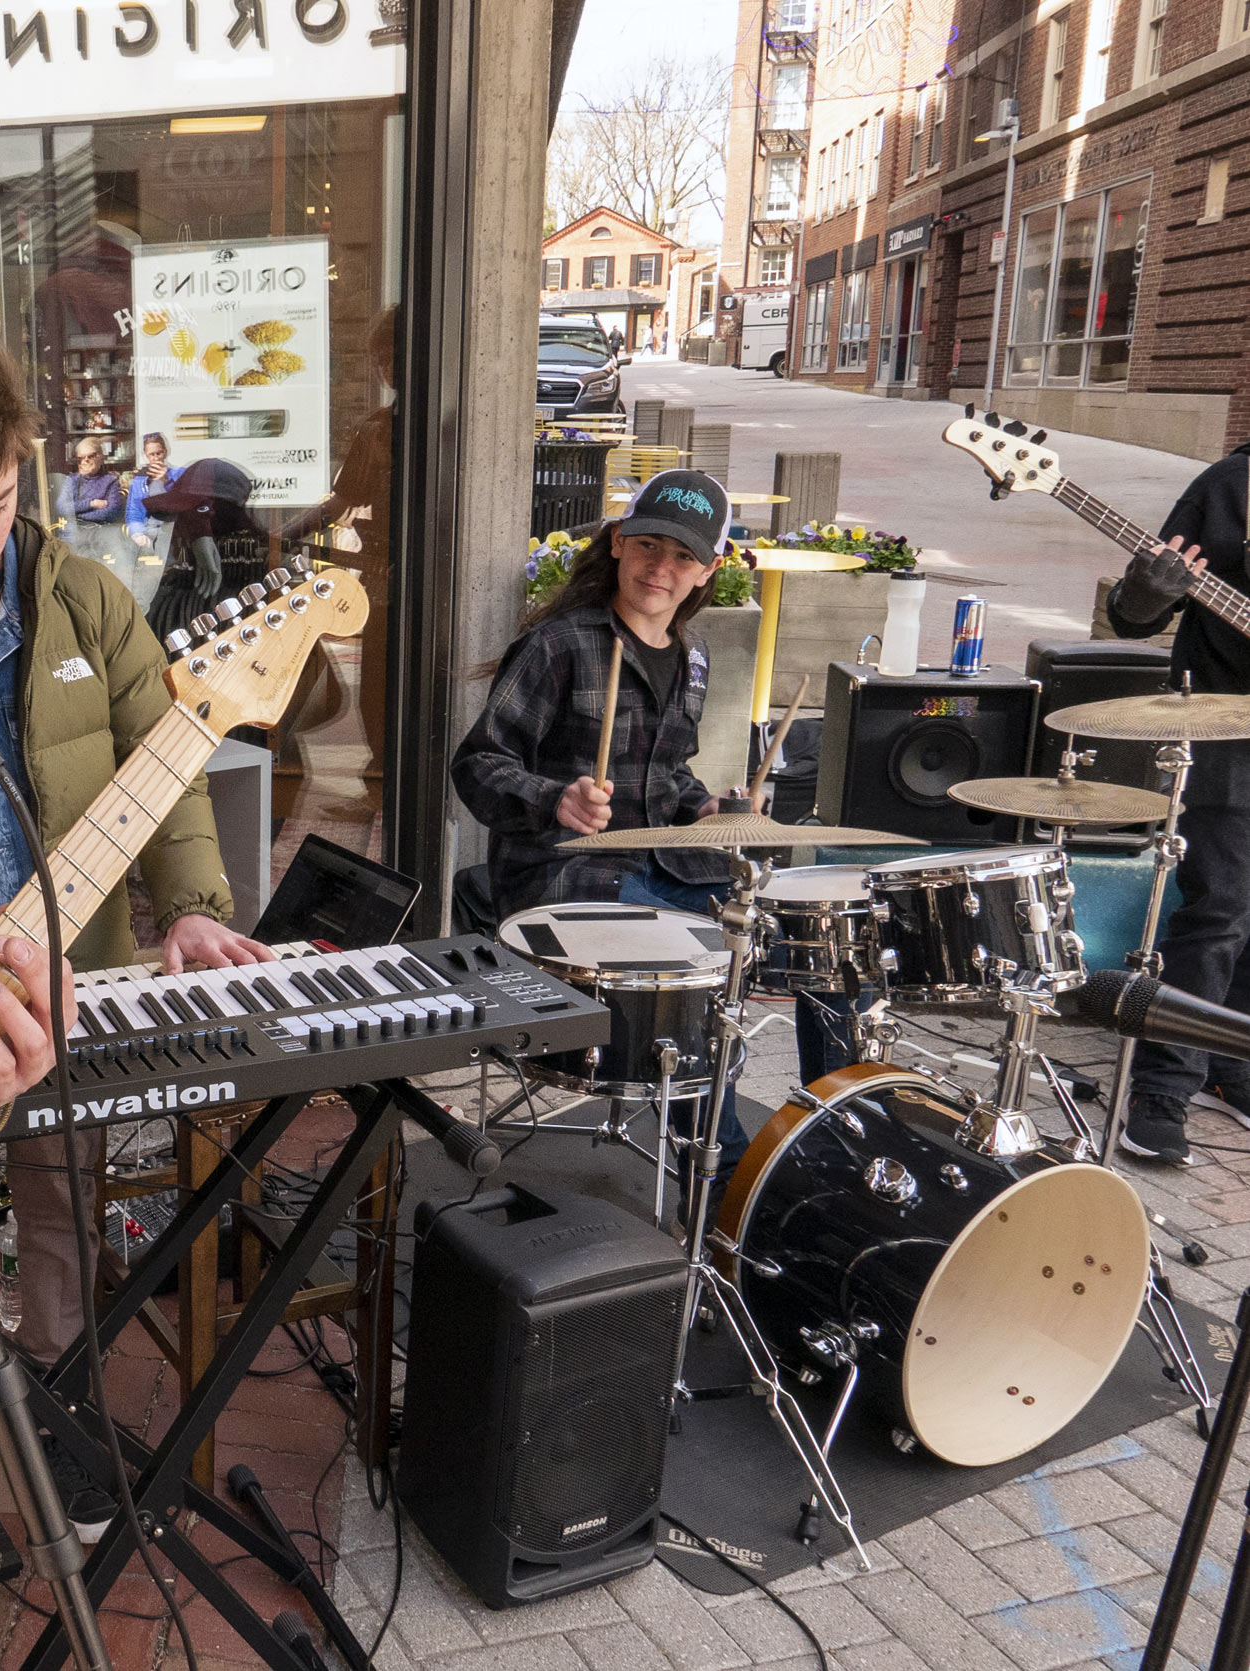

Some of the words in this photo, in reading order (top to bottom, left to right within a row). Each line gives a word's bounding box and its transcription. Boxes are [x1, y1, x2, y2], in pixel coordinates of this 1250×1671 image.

[60, 657, 78, 668] THE
[51, 666, 79, 679] NORTH
[62, 673, 83, 684] FACE
[3, 776, 22, 802] CABLE
[28, 1081, 236, 1129] novation
[563, 1516, 608, 1536] SAMSON
